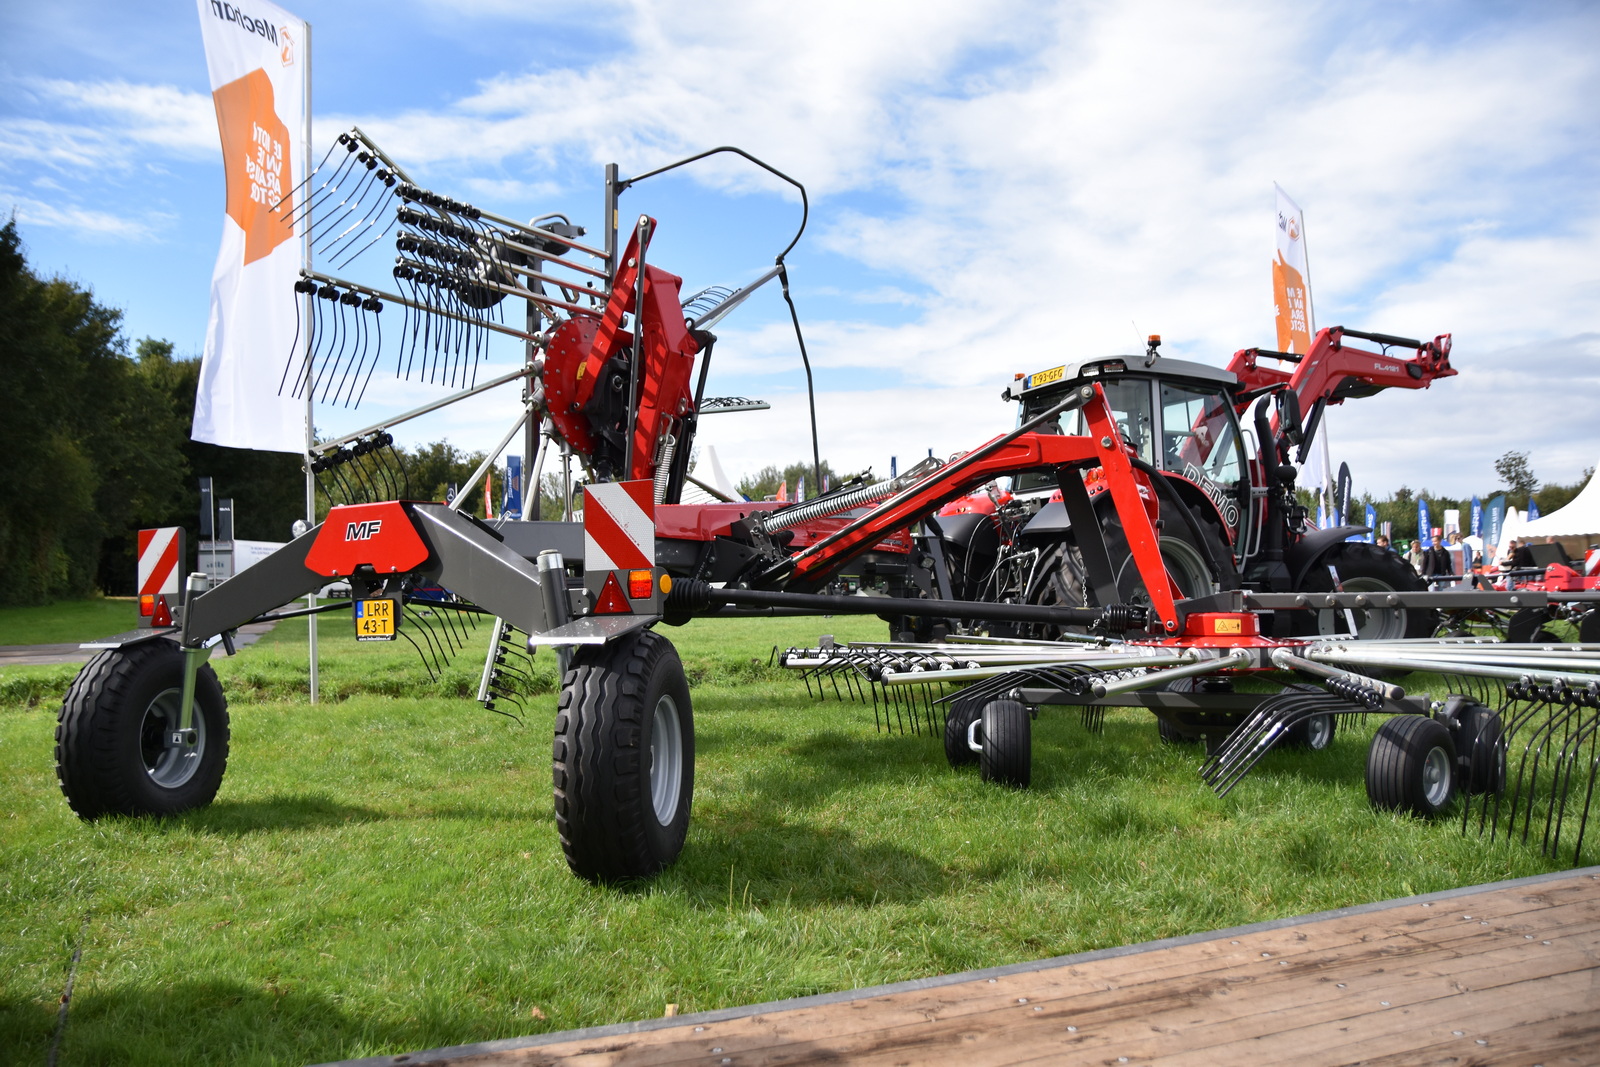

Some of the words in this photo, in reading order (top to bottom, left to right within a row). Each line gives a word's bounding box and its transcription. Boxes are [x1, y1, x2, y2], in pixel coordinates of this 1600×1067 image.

[1033, 369, 1062, 384] T-93-GFG
[1182, 462, 1239, 529] DEMO
[345, 520, 382, 541] MF
[367, 602, 389, 616] LRR
[363, 619, 388, 633] 43-T
